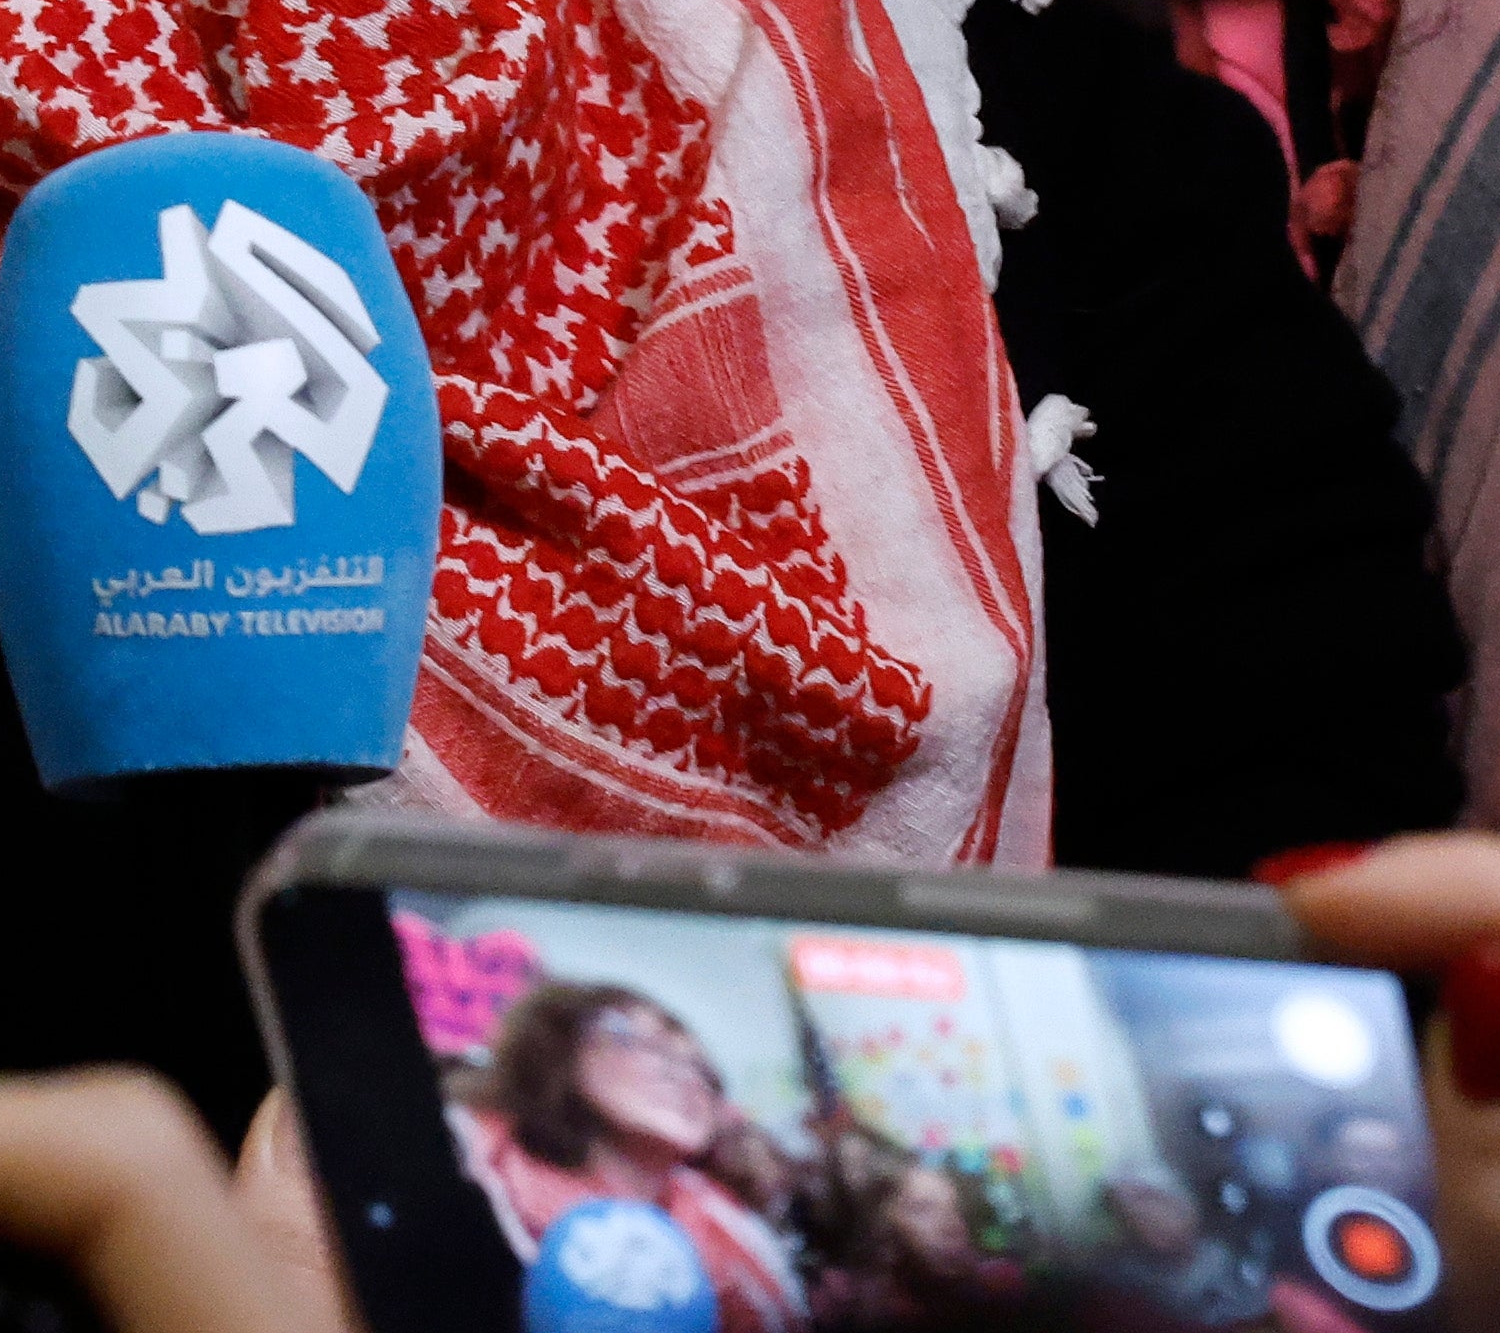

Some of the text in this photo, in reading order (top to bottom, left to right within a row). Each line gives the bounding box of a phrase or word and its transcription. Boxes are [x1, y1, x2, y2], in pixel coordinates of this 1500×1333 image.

[92, 553, 386, 608] التلفزيون العربي
[94, 608, 385, 639] ALARABY TELEVISION
